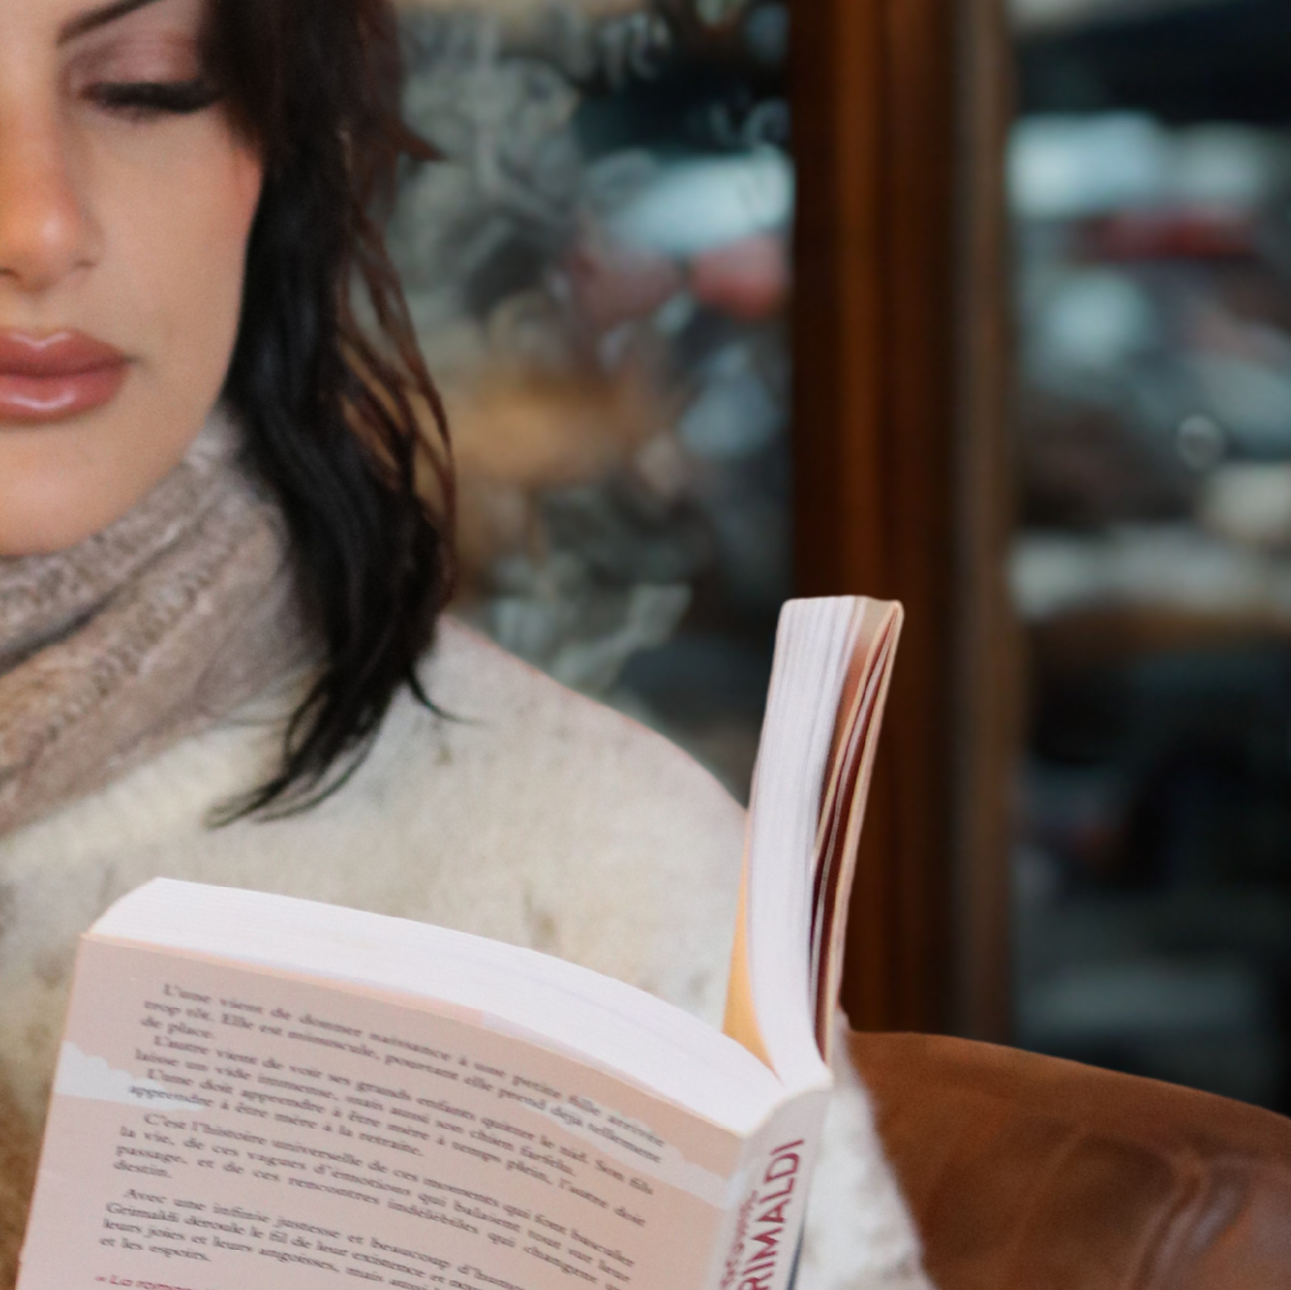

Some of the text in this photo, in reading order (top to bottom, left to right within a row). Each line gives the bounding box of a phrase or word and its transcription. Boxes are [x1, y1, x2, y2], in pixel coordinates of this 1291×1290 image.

[128, 1083, 213, 1107] apprendre
[134, 1047, 179, 1066] laisse
[345, 1095, 384, 1111] mais
[389, 1106, 430, 1124] aussi
[435, 1119, 464, 1134] son
[469, 1130, 514, 1152] chien
[143, 997, 181, 1017] trop
[220, 1012, 254, 1029] Elle
[259, 1023, 283, 1035] est
[384, 1053, 459, 1080] pourtant
[463, 1075, 493, 1091] elle
[497, 1086, 545, 1110] prend
[219, 998, 264, 1014] vient
[298, 1012, 362, 1037] donner
[369, 1032, 451, 1061] naissance
[473, 1061, 506, 1079] une
[511, 1074, 562, 1100] petite
[567, 1093, 600, 1116] fille
[199, 1078, 233, 1094] doit
[240, 1089, 325, 1113] apprendre
[451, 1138, 501, 1164] temps
[614, 1202, 645, 1228] doit
[216, 1049, 258, 1065] vient
[289, 1064, 322, 1078] voir
[327, 1073, 351, 1085] ses
[355, 1080, 411, 1101] grands
[416, 1096, 476, 1120] enfants
[480, 1115, 535, 1141] quitter
[594, 1157, 625, 1182] Son
[628, 1174, 653, 1196] fils
[99, 1236, 116, 1246] et
[121, 1237, 143, 1251] les
[102, 1217, 142, 1233] leurs
[147, 1224, 186, 1241] joies
[191, 1234, 207, 1245] et
[212, 1236, 253, 1253] leurs
[345, 1266, 384, 1282] mais
[105, 1200, 179, 1223] Grimaldi
[249, 1226, 263, 1238] le
[269, 1230, 288, 1243] fil
[291, 1234, 311, 1248] de
[316, 1240, 348, 1257] leur
[351, 1251, 425, 1277] existence
[430, 1272, 445, 1283] et
[124, 1186, 166, 1204] Avec
[173, 1198, 206, 1211] une
[276, 1214, 340, 1238] justesse
[347, 1233, 364, 1244] et
[370, 1236, 451, 1271] beaucoup
[211, 1144, 239, 1156] ces
[247, 1151, 306, 1170] vagues
[417, 1192, 446, 1207] qui
[453, 1200, 521, 1233] balaient
[527, 1227, 561, 1250] tout
[567, 1246, 592, 1264] sur
[598, 1258, 630, 1284] leur
[252, 1169, 280, 1182] ces
[288, 1176, 380, 1205] rencontres
[487, 1231, 516, 1248] qui
[523, 1245, 597, 1284] changent
[393, 1168, 419, 1182] ces
[422, 1176, 500, 1208] moments
[502, 1203, 531, 1220] qui
[534, 1212, 567, 1235] font
[570, 1227, 634, 1269] basculer
[109, 1272, 133, 1286] La
